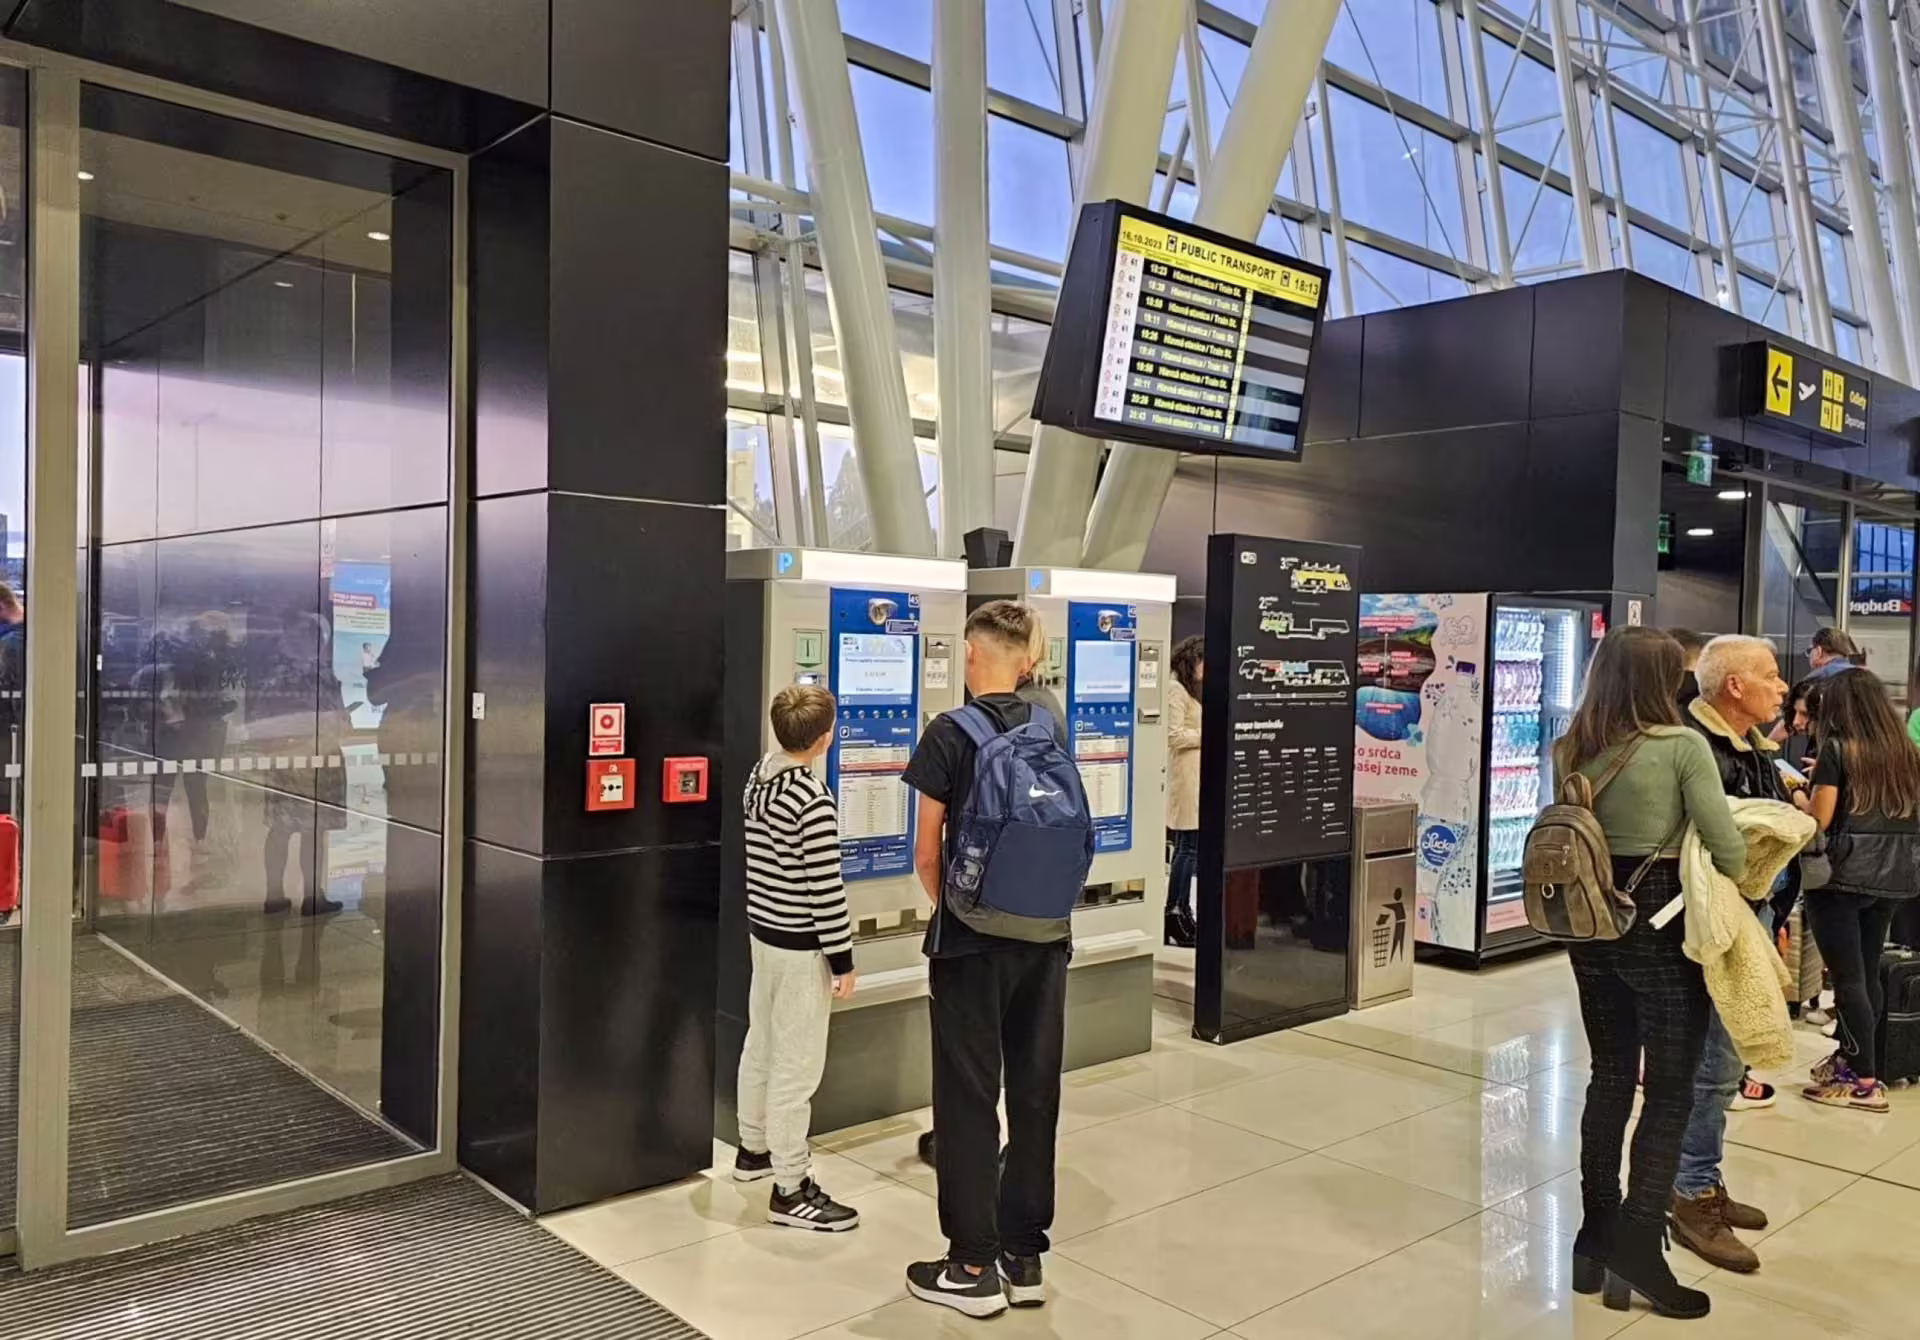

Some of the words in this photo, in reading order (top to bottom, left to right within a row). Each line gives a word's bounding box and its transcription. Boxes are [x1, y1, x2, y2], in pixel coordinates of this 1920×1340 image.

[1121, 229, 1162, 250] 16.10.2023
[1180, 241, 1217, 263] PUBLIC
[1220, 254, 1275, 281] TRANSPORT
[1293, 277, 1319, 295] 18:13
[777, 552, 793, 574] P
[1368, 746, 1401, 760] srdca
[1354, 759, 1381, 776] ašej
[1384, 765, 1418, 777] zeme
